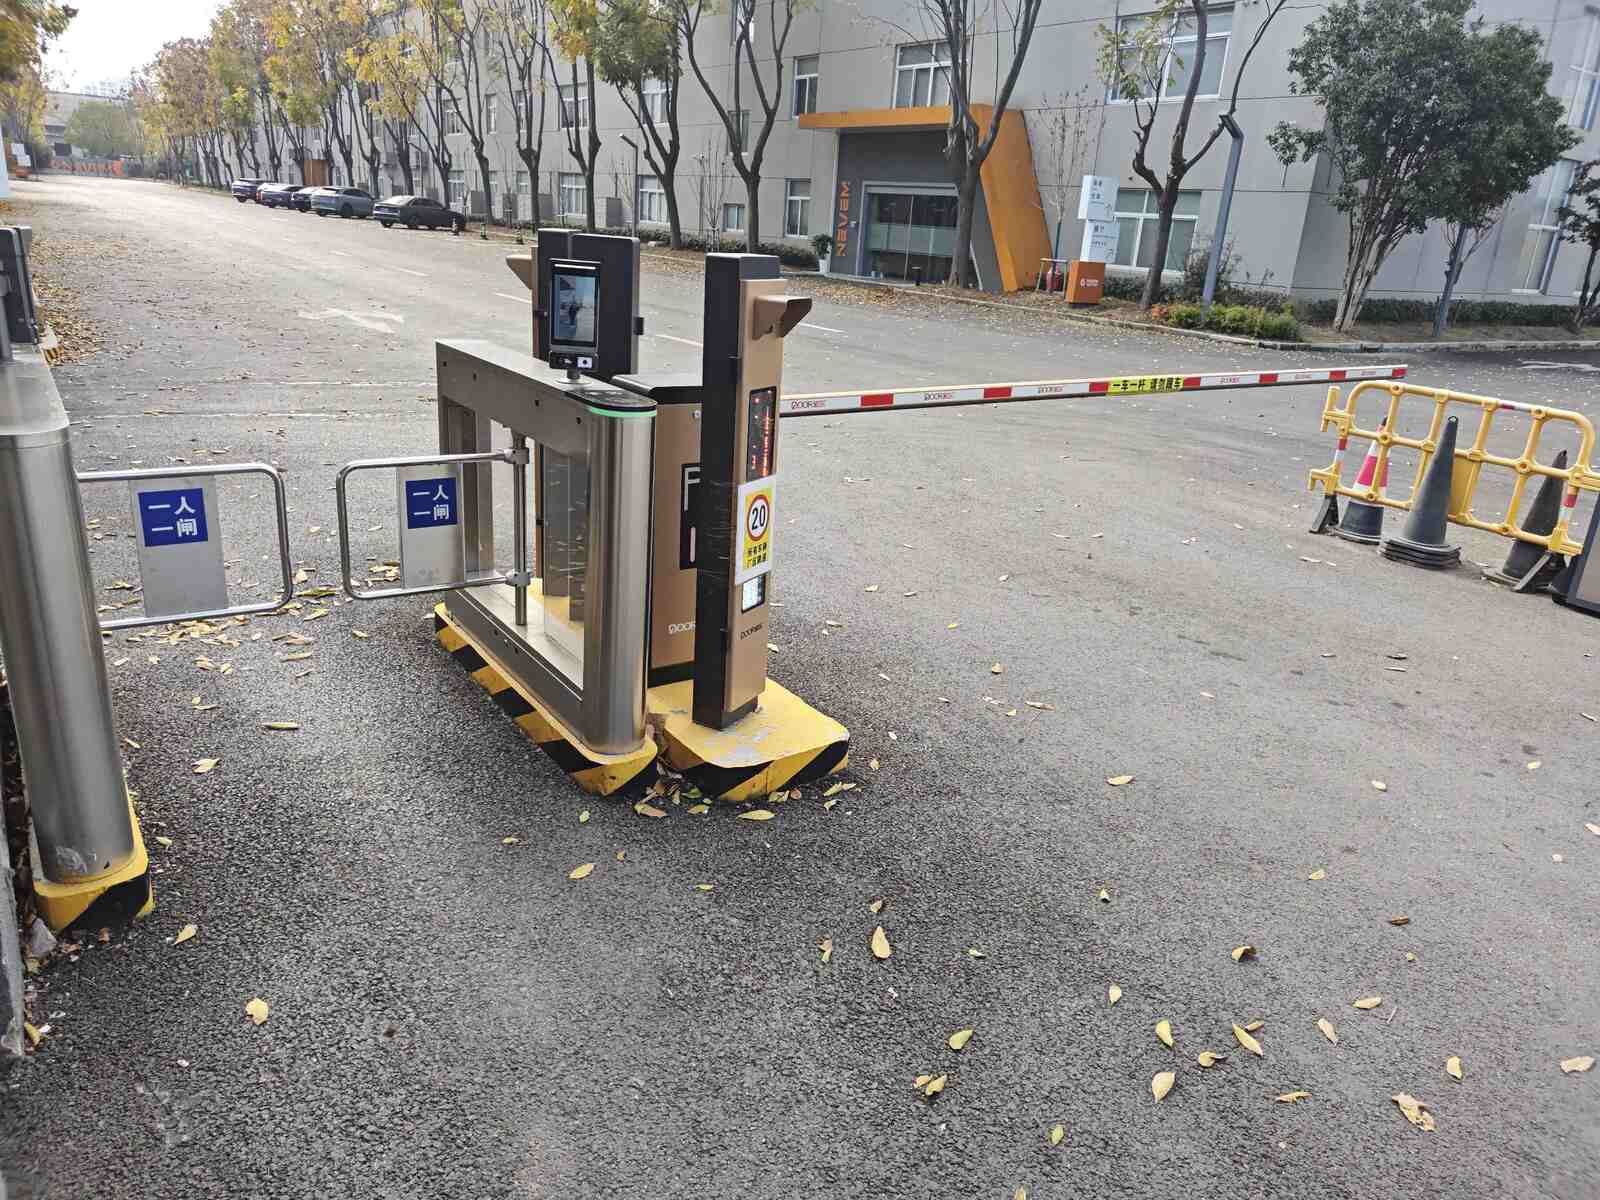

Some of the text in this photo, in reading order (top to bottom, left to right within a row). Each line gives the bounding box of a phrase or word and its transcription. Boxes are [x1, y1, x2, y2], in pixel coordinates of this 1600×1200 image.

[413, 484, 449, 501] 一人
[148, 496, 195, 517] 一人
[413, 504, 449, 520] 一闸
[751, 504, 766, 531] 20
[152, 518, 198, 537] 一闸
